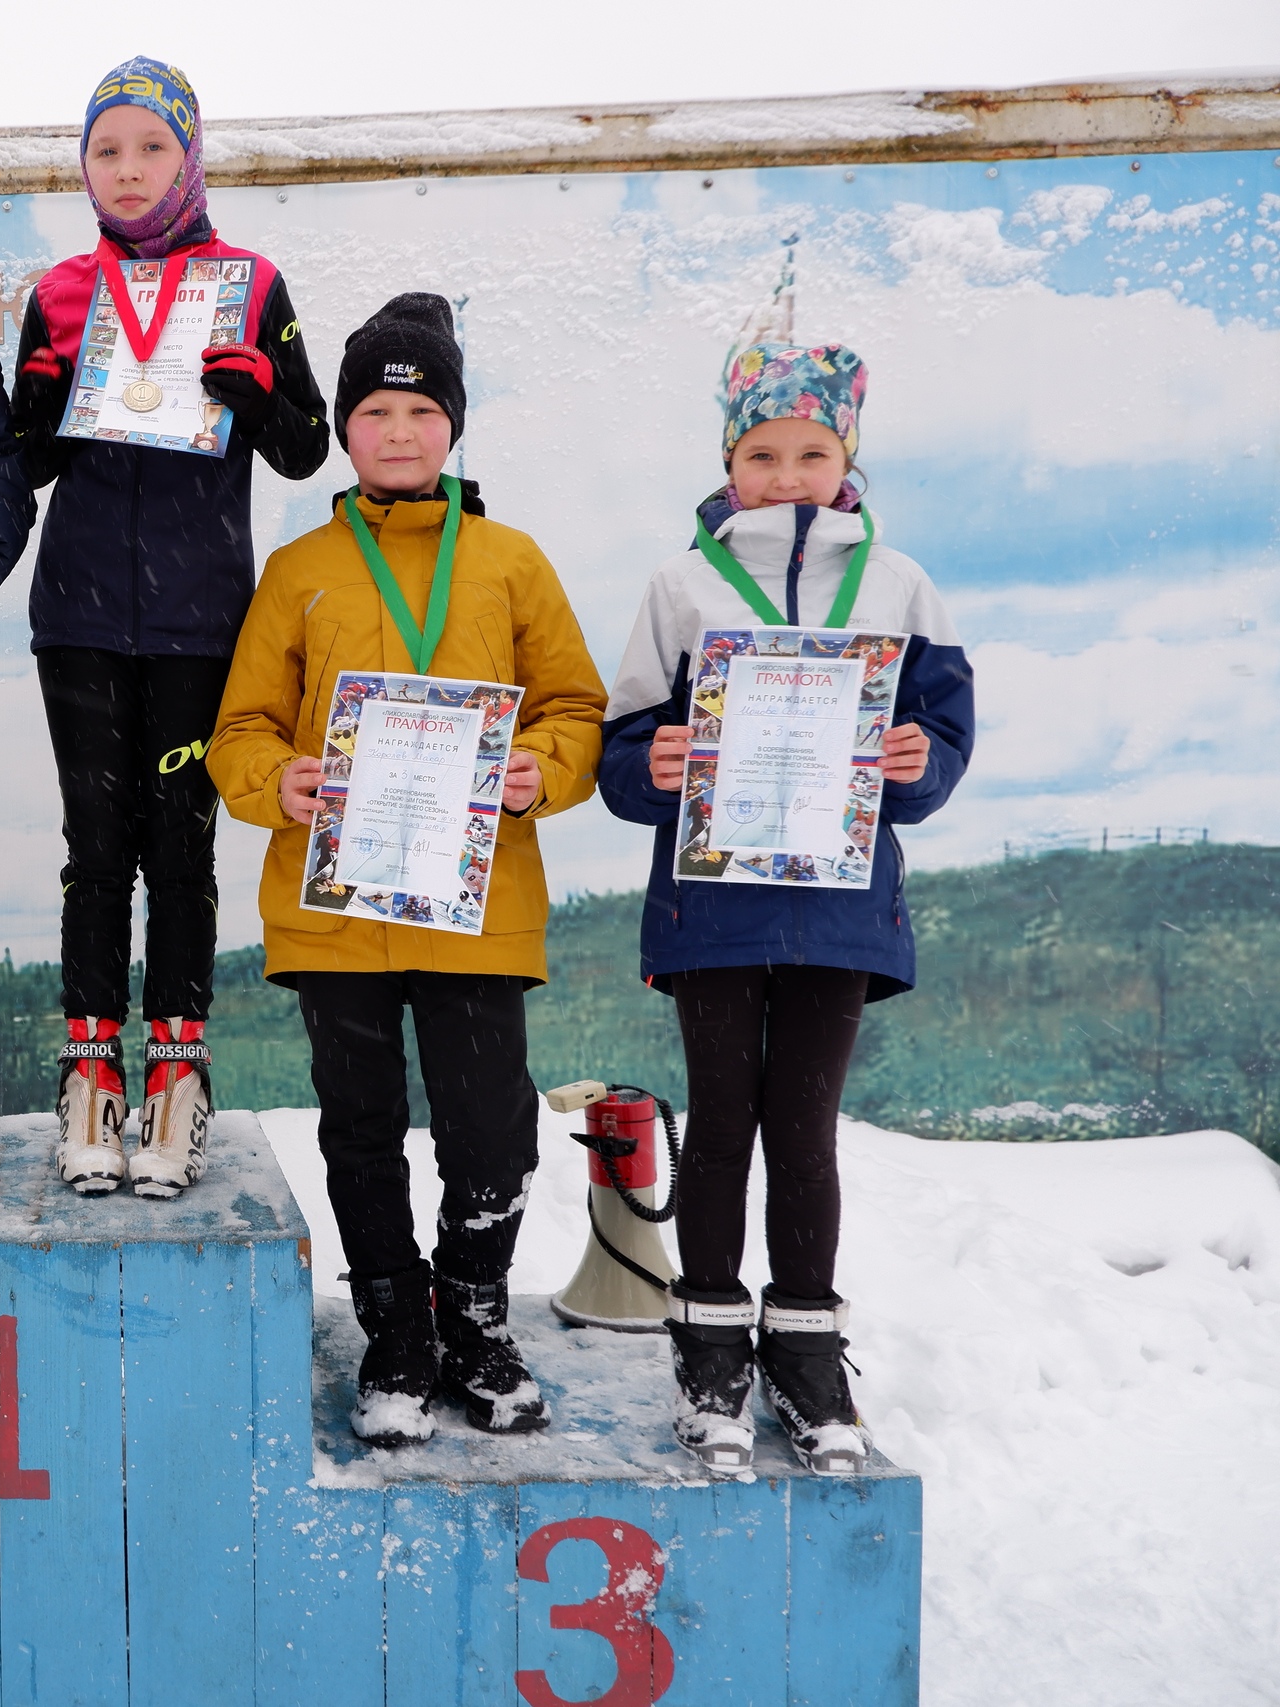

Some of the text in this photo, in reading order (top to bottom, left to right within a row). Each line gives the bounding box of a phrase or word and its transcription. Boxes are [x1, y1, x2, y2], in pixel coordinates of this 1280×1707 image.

[137, 290, 205, 302] ГРОТА
[384, 364, 416, 375] BREAK
[756, 673, 832, 686] ГРАМОТА
[748, 695, 838, 704] НАГРАЖДАЕТСЯ
[385, 717, 454, 734] ГРАМОТА
[378, 738, 458, 752] НАГРАЖДАЕТСЯ
[62, 1044, 116, 1056] SSIGNOL
[514, 1516, 675, 1707] 3
